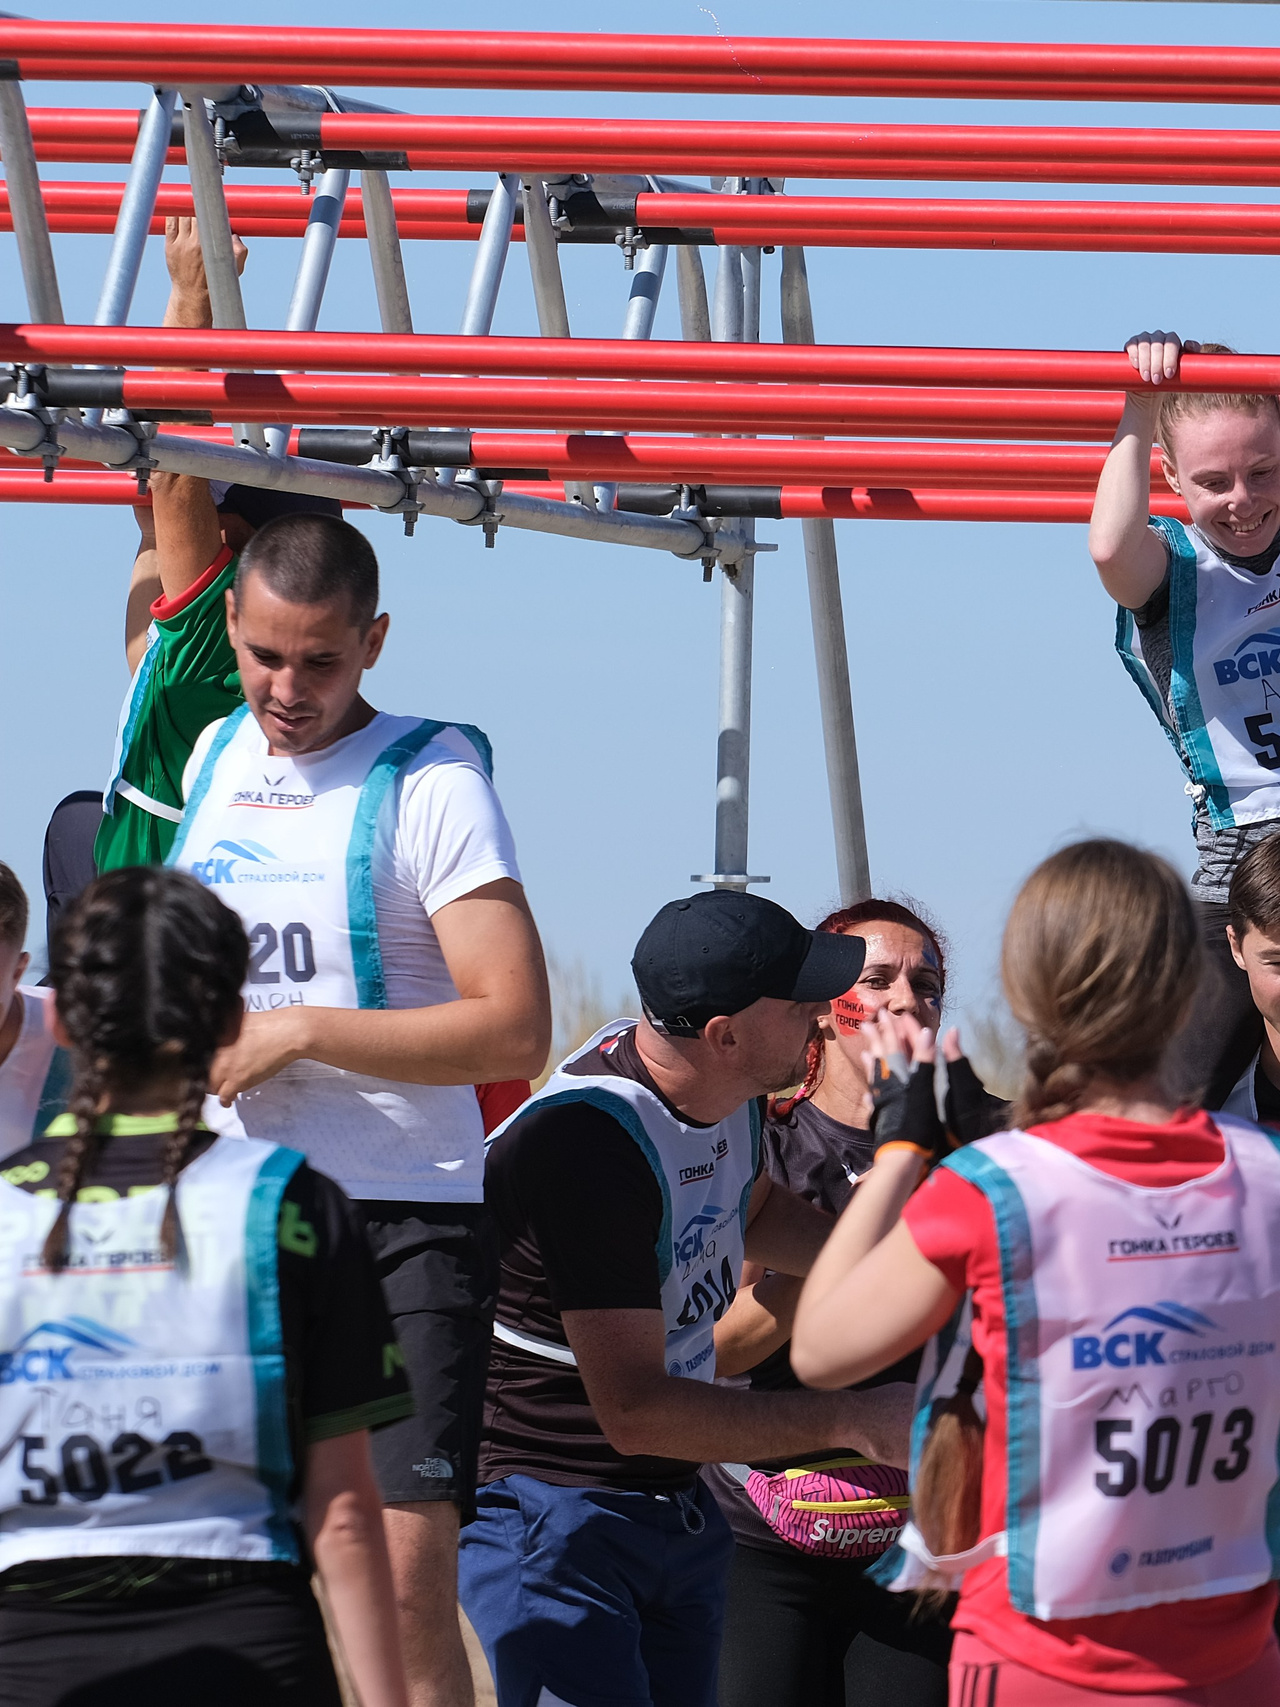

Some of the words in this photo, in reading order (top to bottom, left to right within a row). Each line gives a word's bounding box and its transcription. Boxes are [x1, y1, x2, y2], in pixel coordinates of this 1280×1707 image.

[237, 870, 300, 884] СТРАХОВОЙ
[301, 873, 325, 884] ДОМ
[837, 998, 865, 1014] ГОНКА
[835, 1013, 862, 1030] ГЕРОЕ
[678, 1161, 715, 1182] ГОНКА
[1108, 1239, 1167, 1255] ГОНКА
[1172, 1230, 1237, 1252] ГЕРОЕВ
[1073, 1332, 1165, 1370] ВСК
[1095, 1407, 1255, 1498] 5013
[20, 1431, 214, 1505] 5022
[809, 1518, 904, 1550] Suprem
